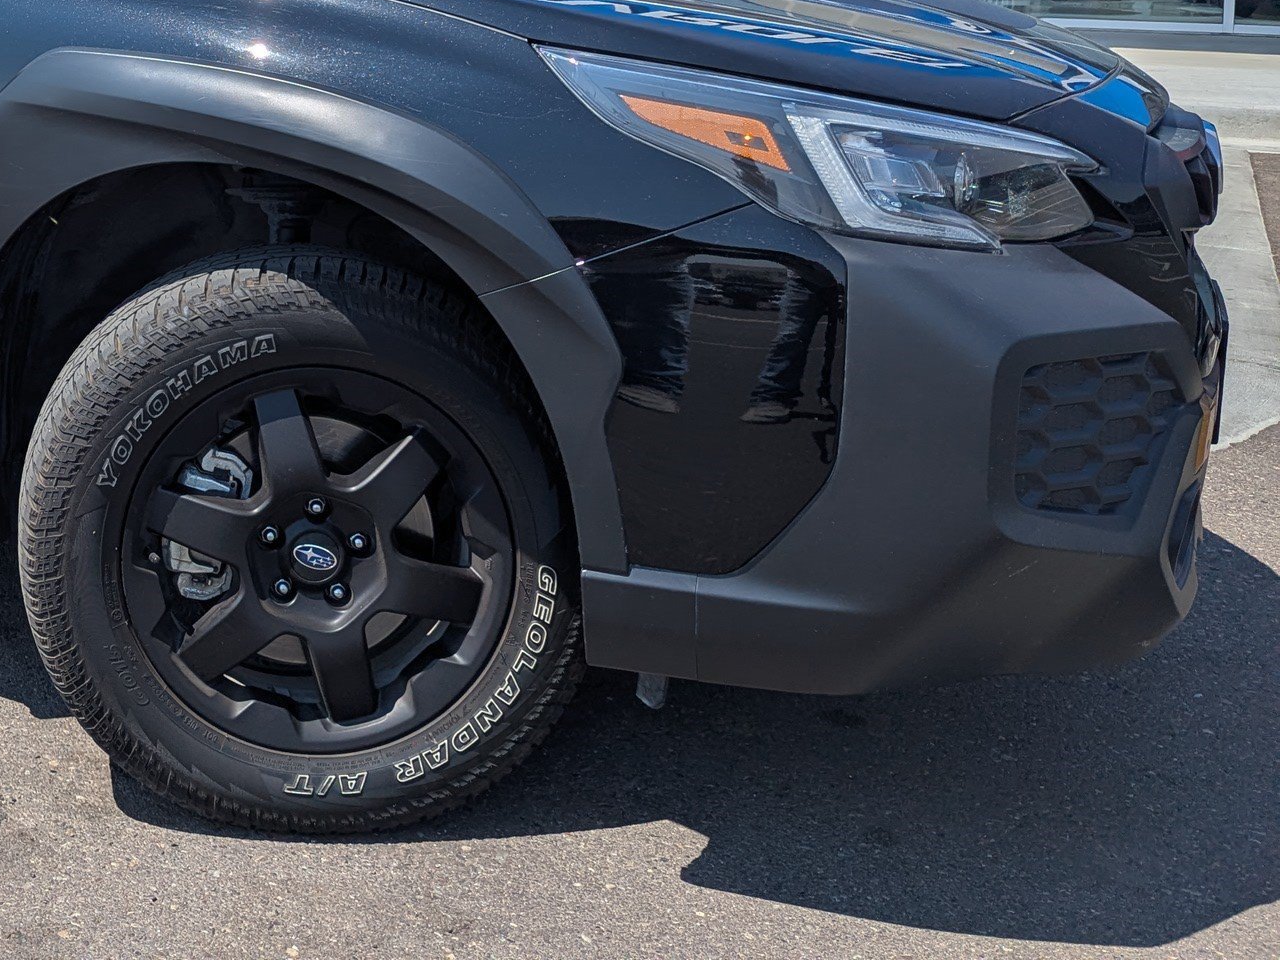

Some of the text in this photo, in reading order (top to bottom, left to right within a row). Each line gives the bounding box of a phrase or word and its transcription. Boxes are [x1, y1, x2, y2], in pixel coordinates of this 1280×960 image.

[96, 333, 277, 488] YOKOHAMA
[283, 564, 558, 796] GEOLANDAR A/T
